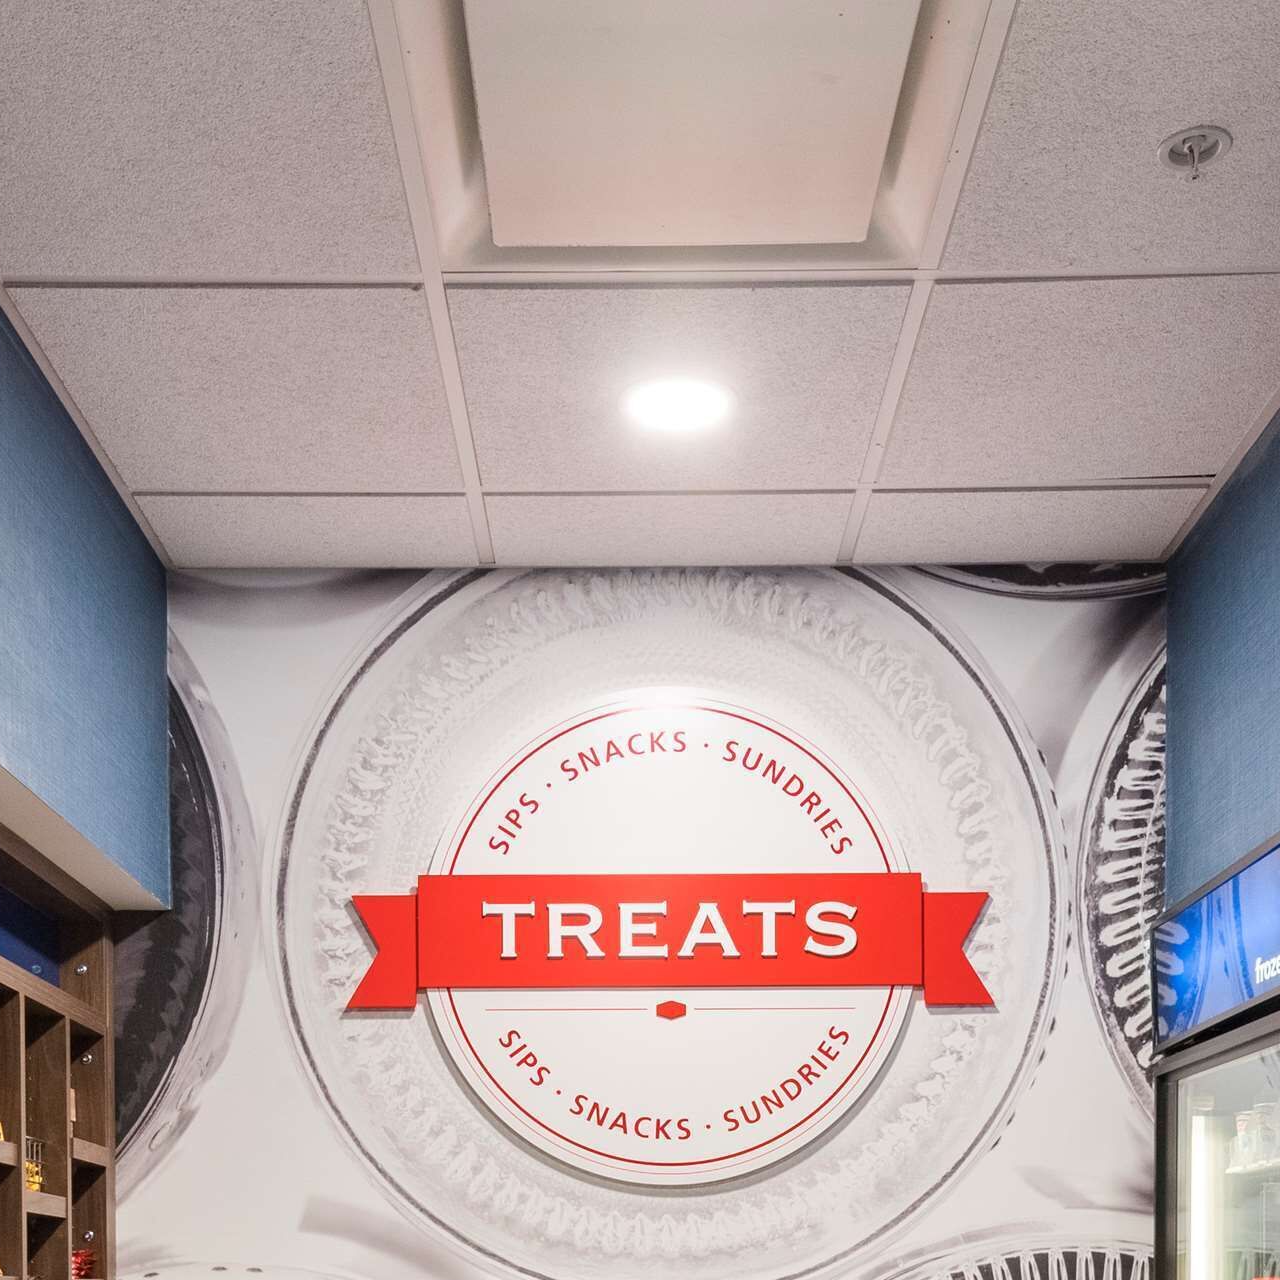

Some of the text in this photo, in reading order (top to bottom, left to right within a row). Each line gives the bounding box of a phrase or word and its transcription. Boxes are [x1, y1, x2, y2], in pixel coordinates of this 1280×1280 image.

[488, 730, 854, 857] SIPS SNACKS SUNDRIES
[482, 900, 859, 960] TREATS
[499, 1024, 851, 1141] SIPS SNACKS SUNDRIES
